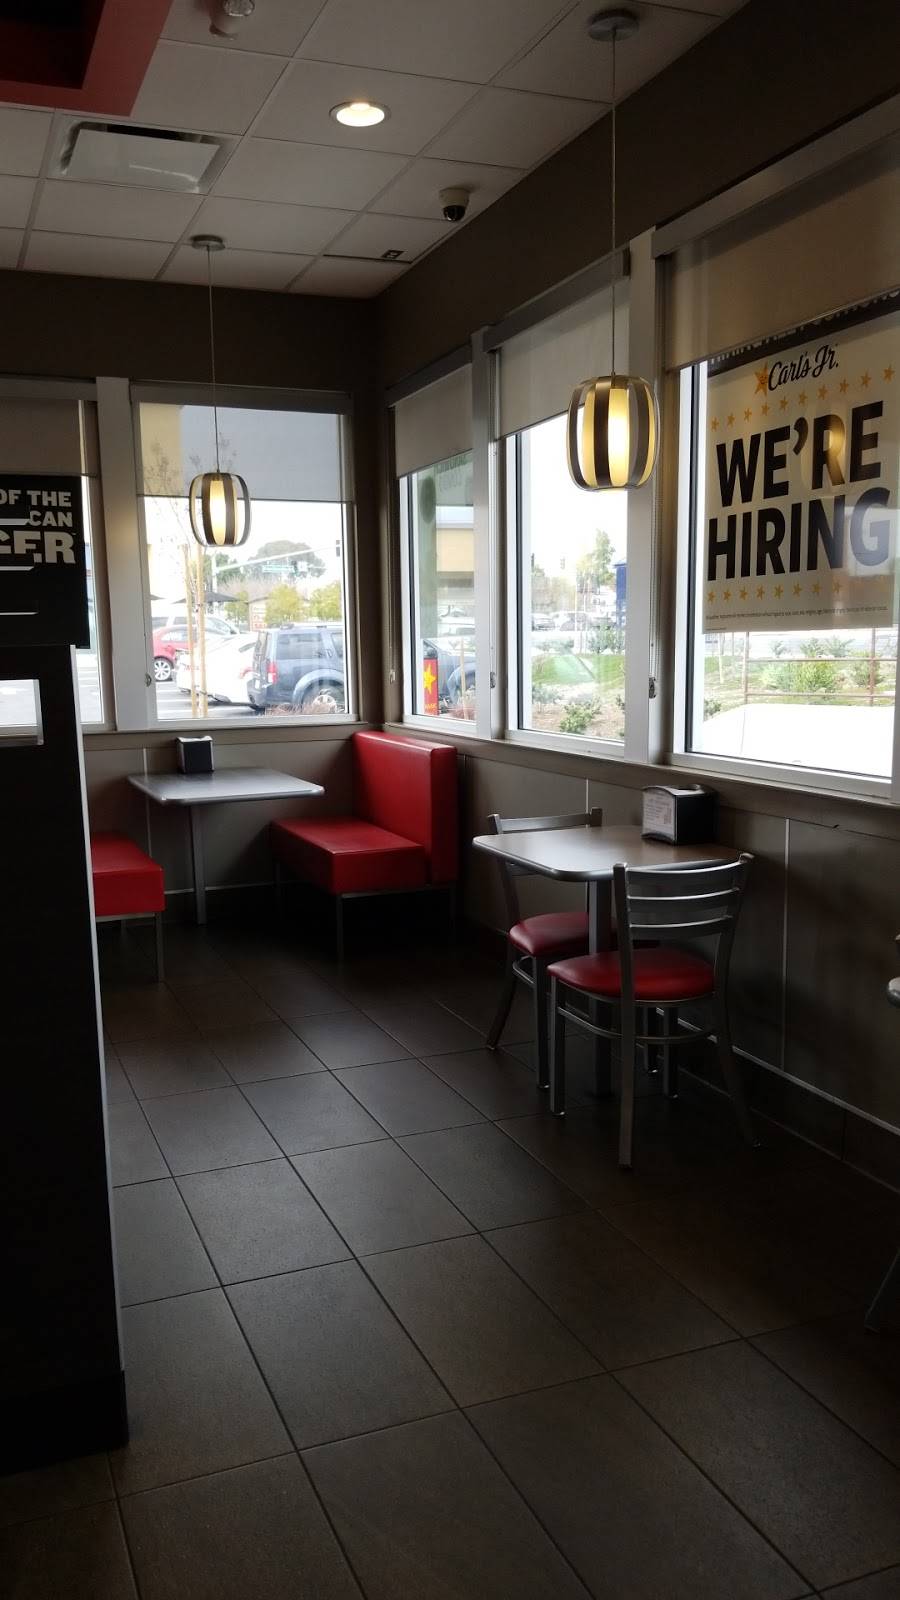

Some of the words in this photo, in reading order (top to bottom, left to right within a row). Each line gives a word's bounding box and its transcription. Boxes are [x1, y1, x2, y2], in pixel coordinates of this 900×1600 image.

[768, 351, 811, 391] Carl's
[812, 345, 839, 378] Jr.
[716, 401, 883, 507] WE'RE
[26, 490, 72, 507] THE
[708, 487, 890, 581] HIRING
